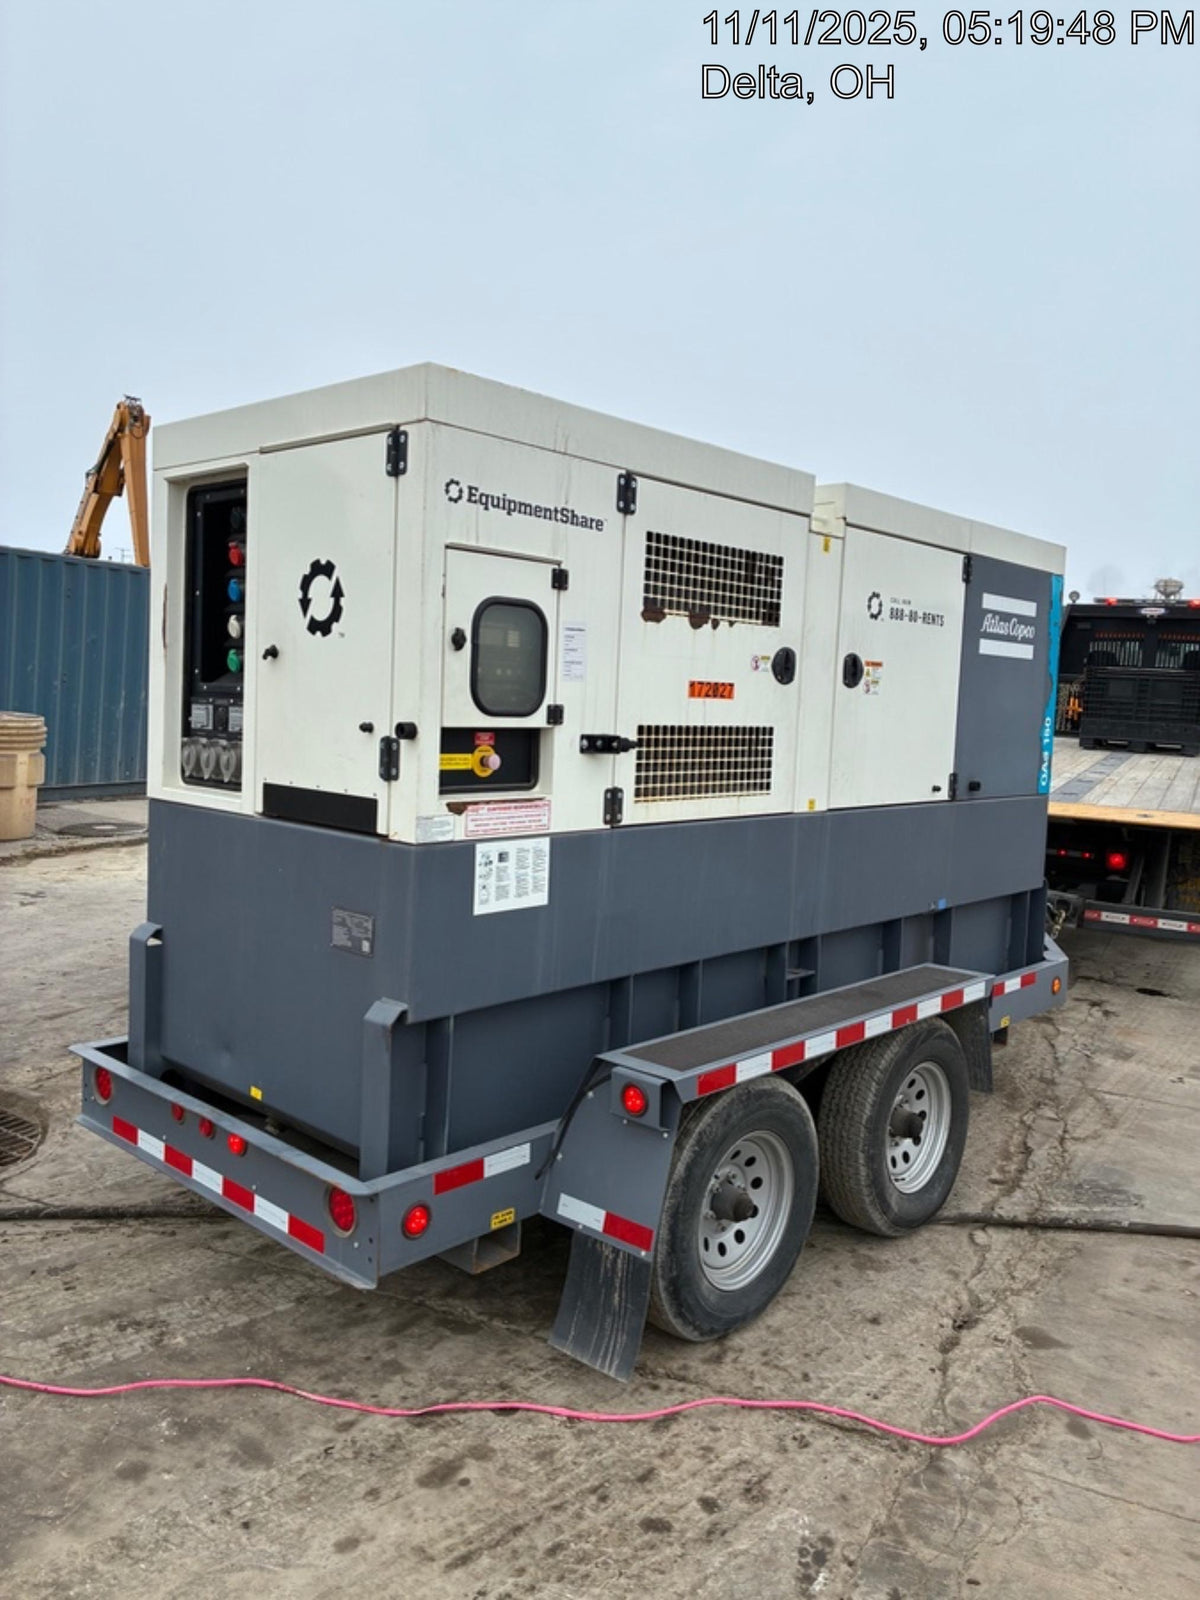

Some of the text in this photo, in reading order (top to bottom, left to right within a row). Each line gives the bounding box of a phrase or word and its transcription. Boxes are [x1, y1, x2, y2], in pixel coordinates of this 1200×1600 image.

[466, 485, 604, 532] EquipmentShare
[980, 612, 1036, 641] Atlas Copco
